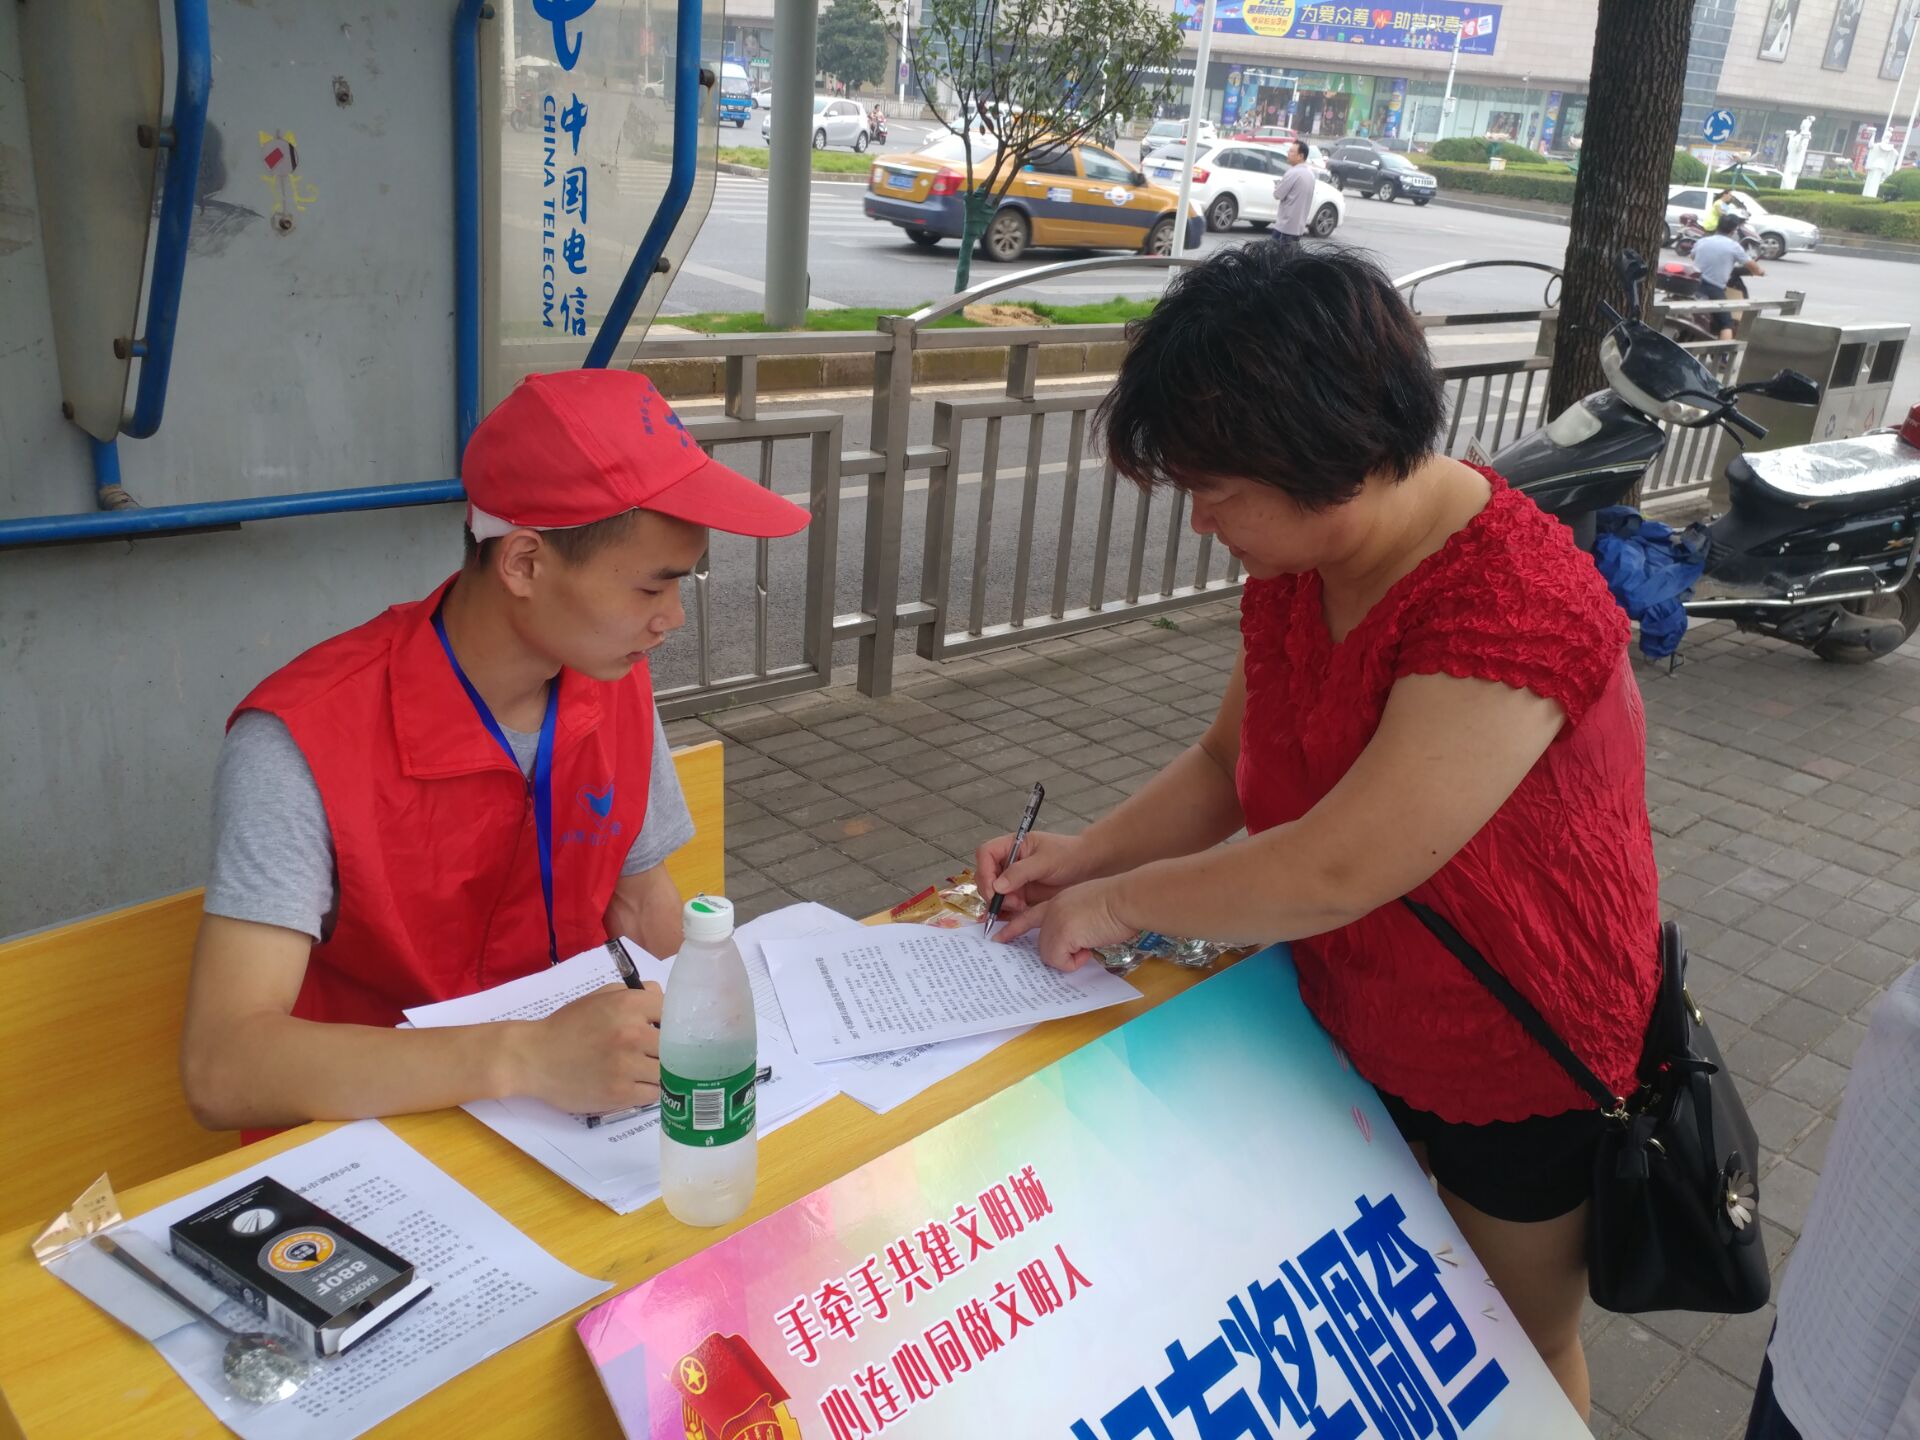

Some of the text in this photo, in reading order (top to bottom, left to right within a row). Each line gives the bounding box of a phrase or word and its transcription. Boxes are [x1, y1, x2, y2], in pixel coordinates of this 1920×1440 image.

[1300, 5, 1370, 27] 为爱众筹
[542, 95, 556, 328] CHINA TELECOM
[561, 92, 588, 337] 中国电信
[316, 1260, 368, 1296] 880F
[776, 1164, 1054, 1364] 手牵手共建文明城
[819, 1243, 1094, 1440] 心连心同做文明人
[1070, 1194, 1510, 1440] 有奖调查
